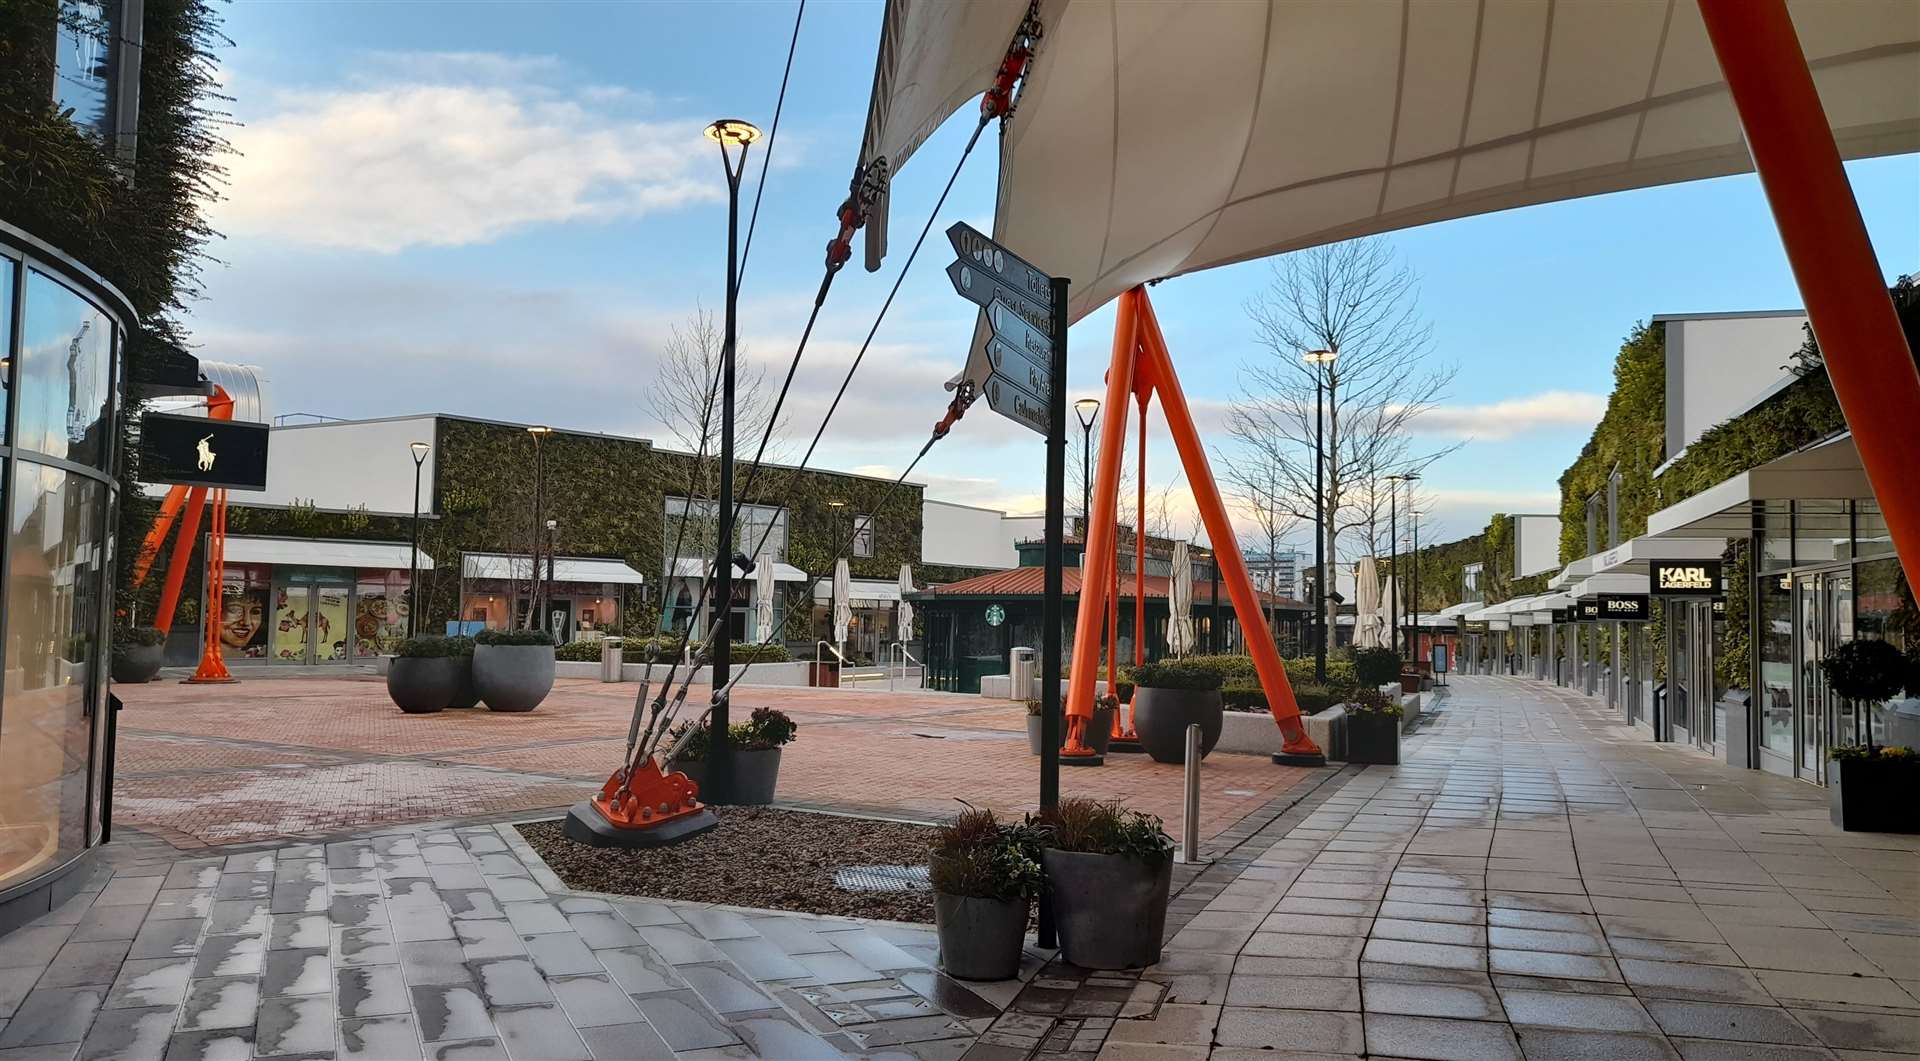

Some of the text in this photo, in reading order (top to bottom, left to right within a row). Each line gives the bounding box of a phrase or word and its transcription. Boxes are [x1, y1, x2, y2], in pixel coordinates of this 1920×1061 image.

[1026, 270, 1051, 300] Toilets
[1018, 300, 1050, 333] Services
[1659, 567, 1711, 582] KARL
[1659, 581, 1711, 589] LAGERFELD
[1607, 600, 1639, 609] BOSS
